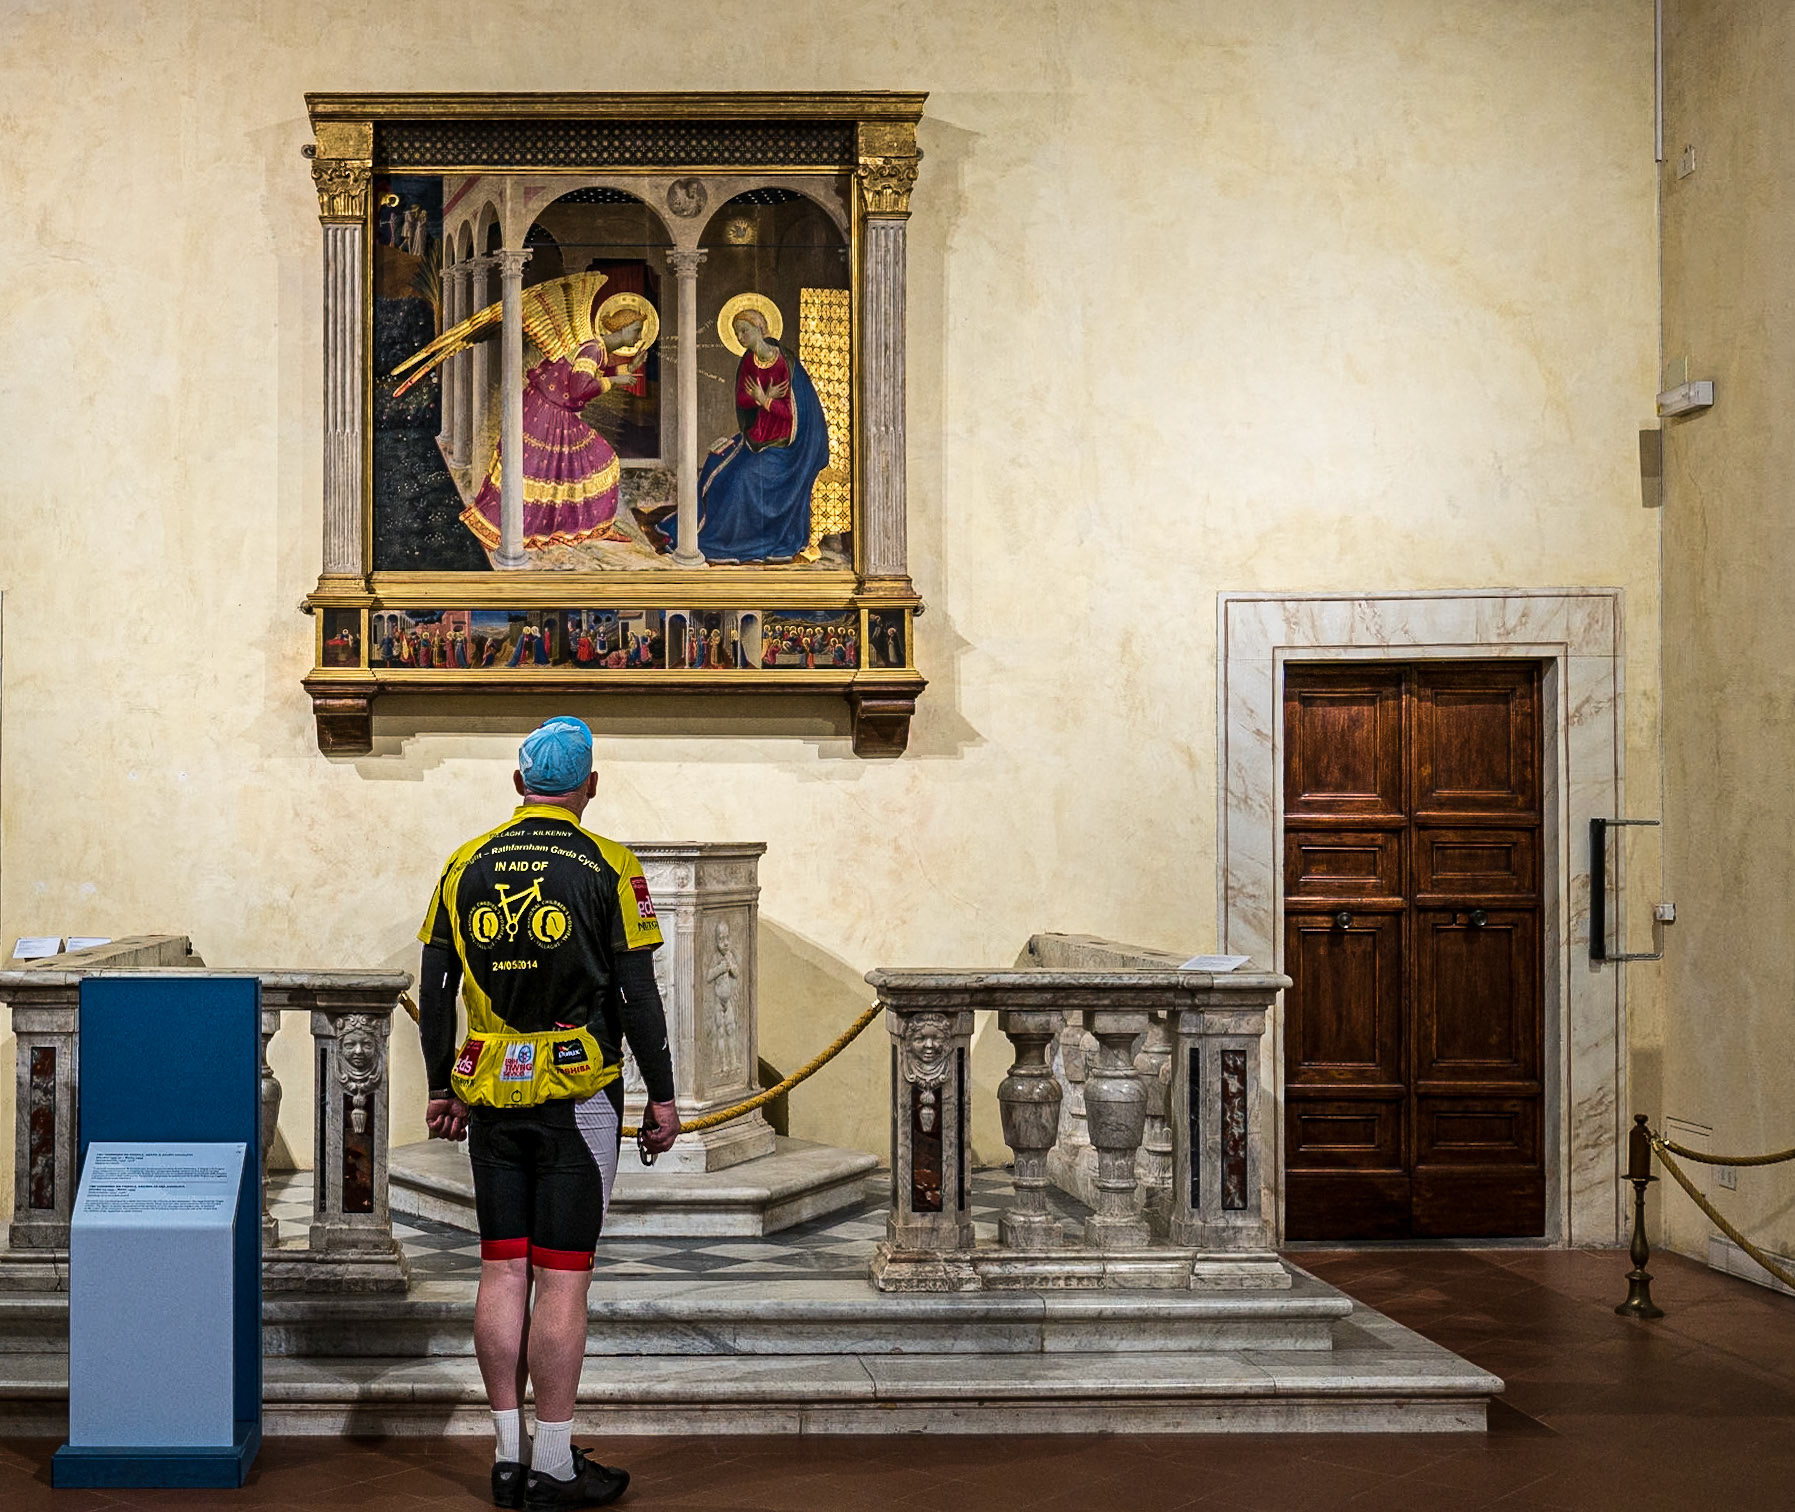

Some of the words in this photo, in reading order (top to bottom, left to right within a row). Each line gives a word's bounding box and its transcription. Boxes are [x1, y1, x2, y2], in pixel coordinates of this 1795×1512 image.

[532, 830, 573, 838] KILKENNY
[491, 843, 549, 856] Rathfarnham
[550, 845, 577, 859] Garda
[494, 861, 506, 872] IN
[508, 861, 530, 872] AID
[531, 860, 549, 872] OF
[555, 1064, 592, 1074] TOSHIBA
